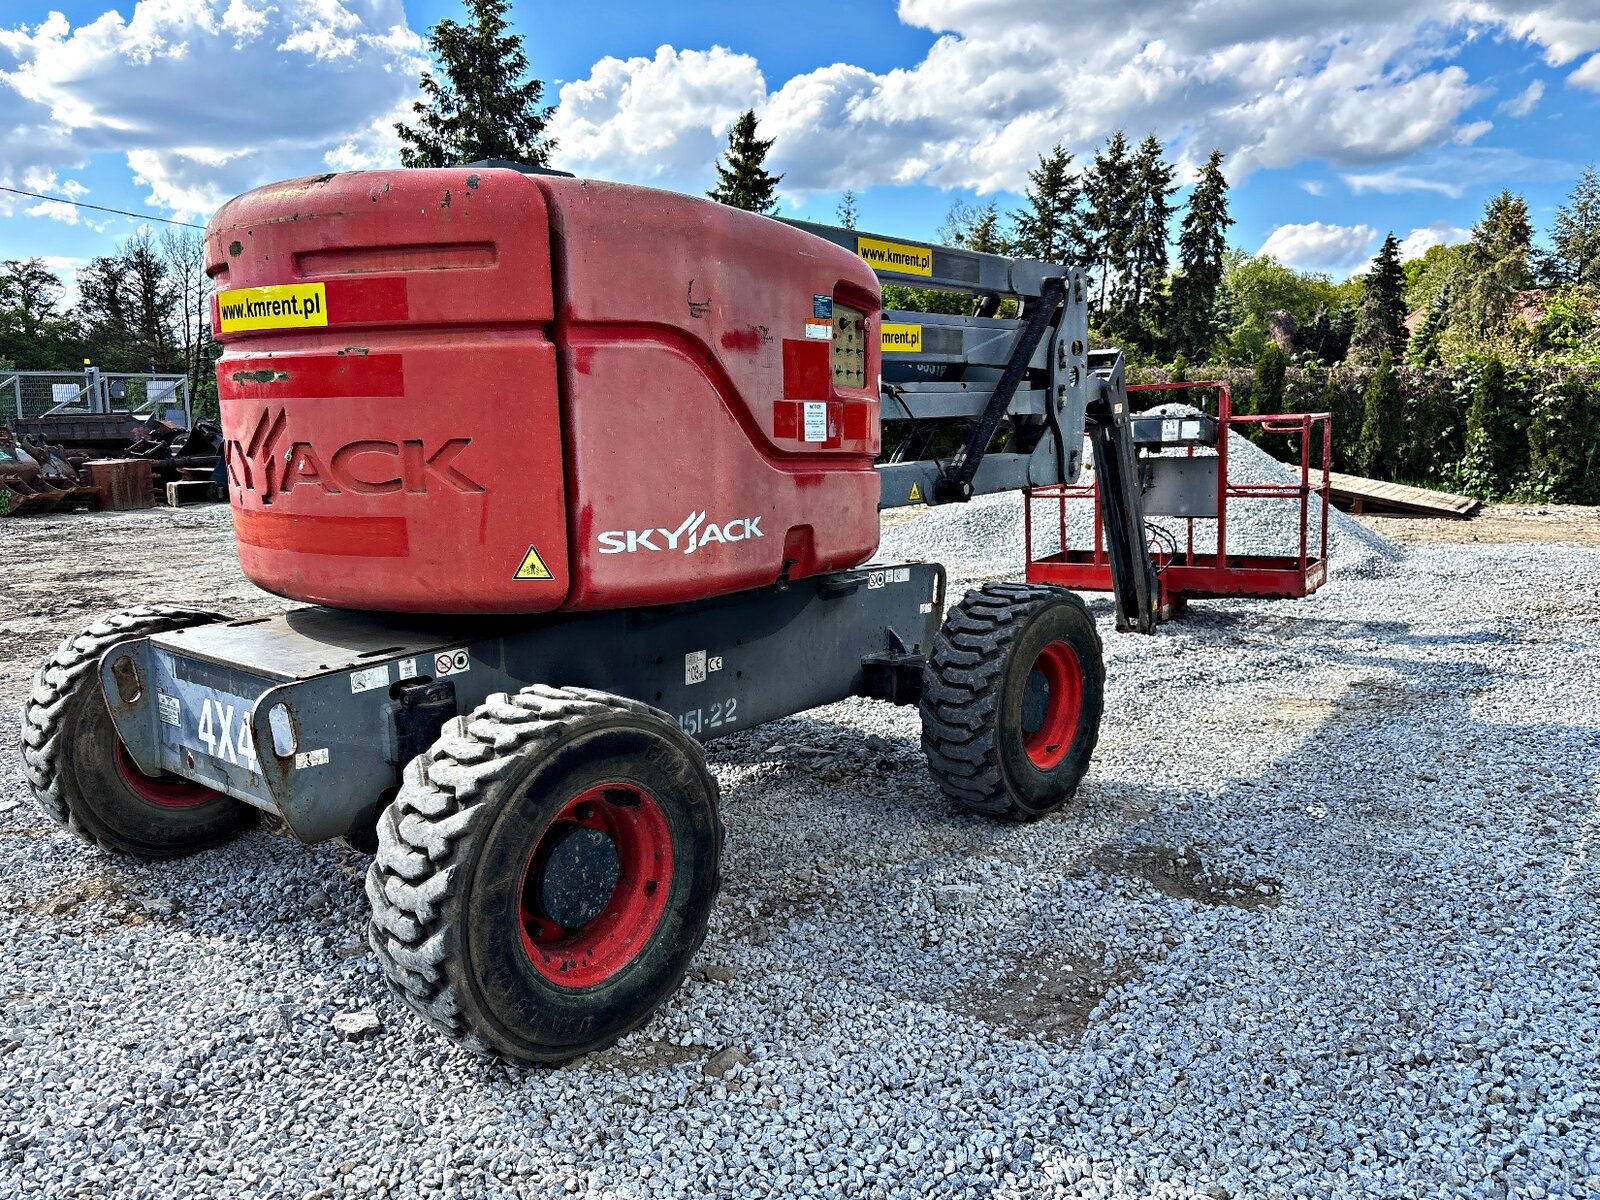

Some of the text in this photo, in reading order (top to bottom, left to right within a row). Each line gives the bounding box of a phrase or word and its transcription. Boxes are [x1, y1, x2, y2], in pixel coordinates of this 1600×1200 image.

[860, 246, 930, 270] www.kmrent.pl
[221, 293, 320, 321] www.kmrent.pl
[881, 330, 920, 348] mrent.pl
[598, 509, 765, 555] SKYJACK
[709, 657, 722, 670] CE
[198, 697, 258, 771] 4X4
